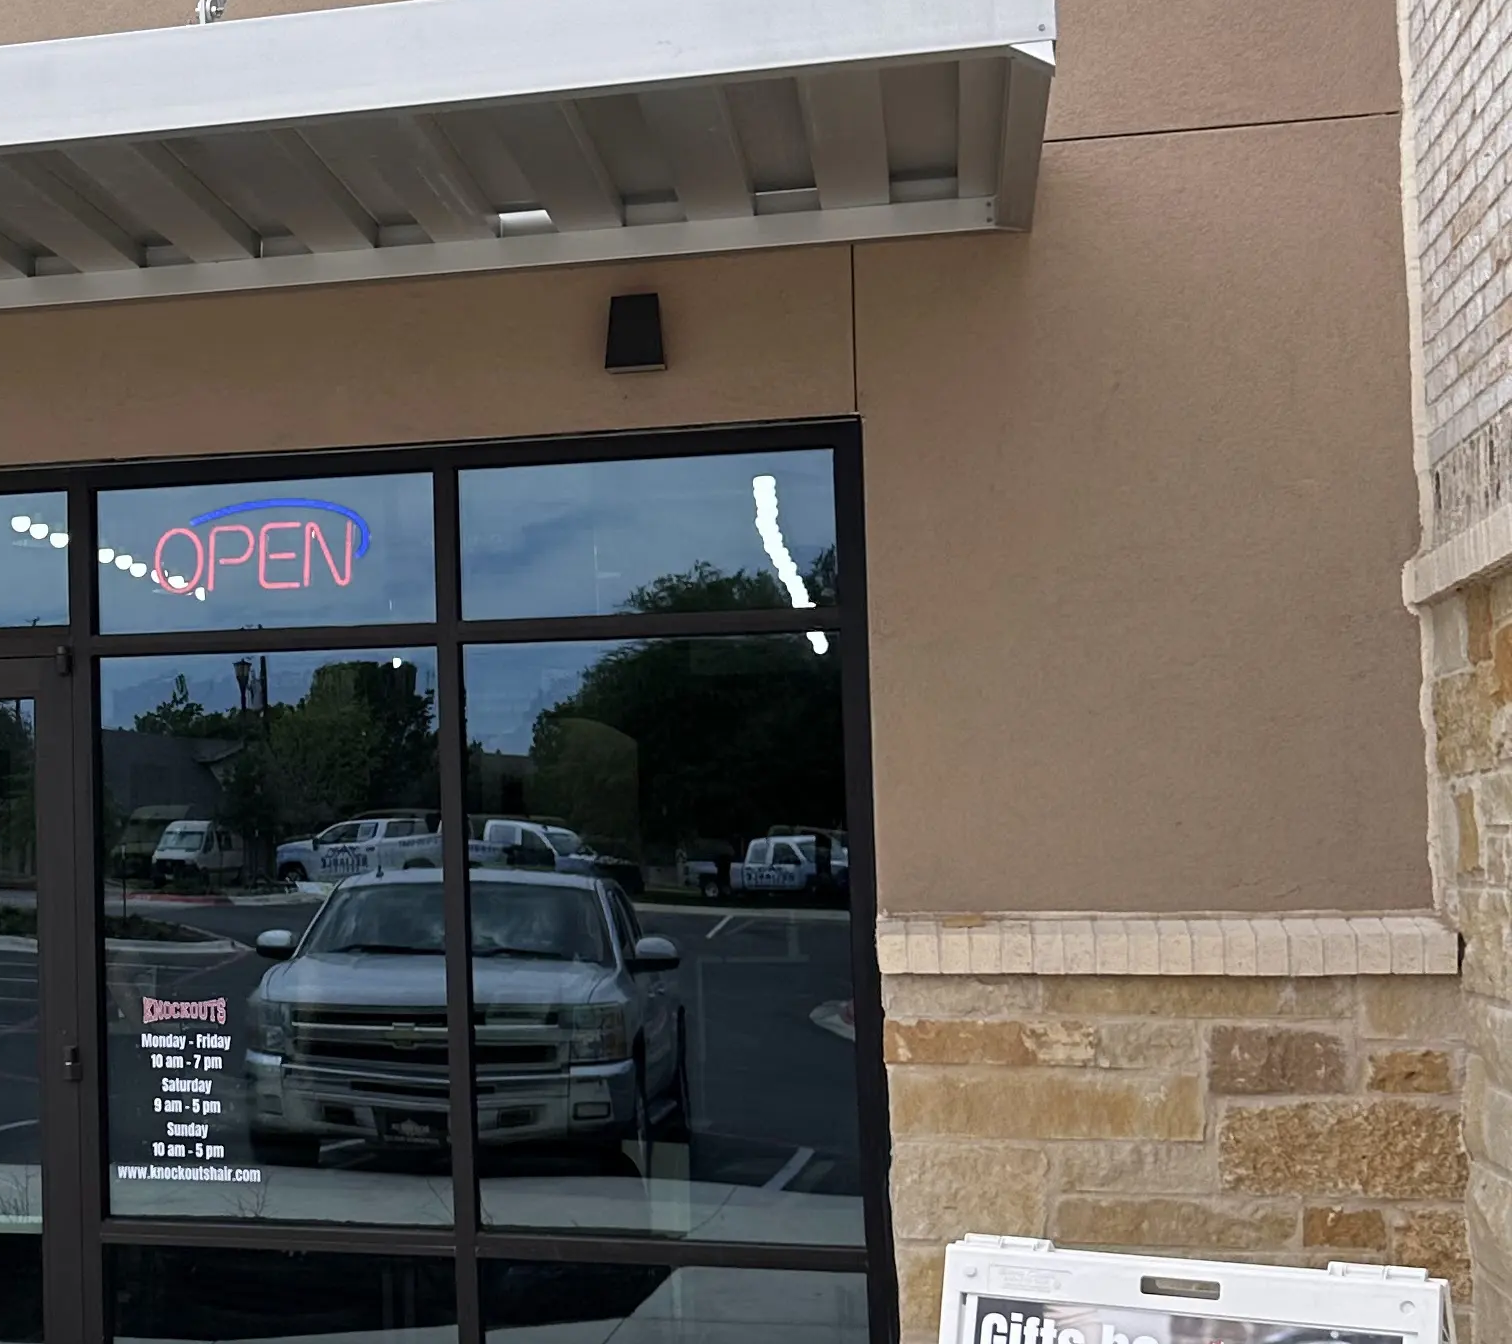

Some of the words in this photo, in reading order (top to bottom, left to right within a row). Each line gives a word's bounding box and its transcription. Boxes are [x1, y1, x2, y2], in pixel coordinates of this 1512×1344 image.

[155, 519, 353, 594] OPEN
[142, 996, 227, 1025] KNOCKOUTS
[141, 1033, 186, 1050] Monday
[196, 1033, 231, 1051] Friday
[151, 1054, 163, 1068] 10
[165, 1055, 184, 1068] am
[193, 1054, 201, 1069] 7
[203, 1056, 223, 1071] pm
[161, 1077, 212, 1094] Saturday
[154, 1097, 162, 1112] 9
[164, 1099, 182, 1113] am
[192, 1098, 200, 1113] 5
[202, 1100, 221, 1115] pm
[167, 1121, 208, 1139] Sunday
[152, 1142, 165, 1156] 10
[167, 1144, 186, 1157] am
[195, 1143, 203, 1158] 5
[206, 1145, 225, 1160] pm
[117, 1165, 262, 1183] www.knockoutshair.com
